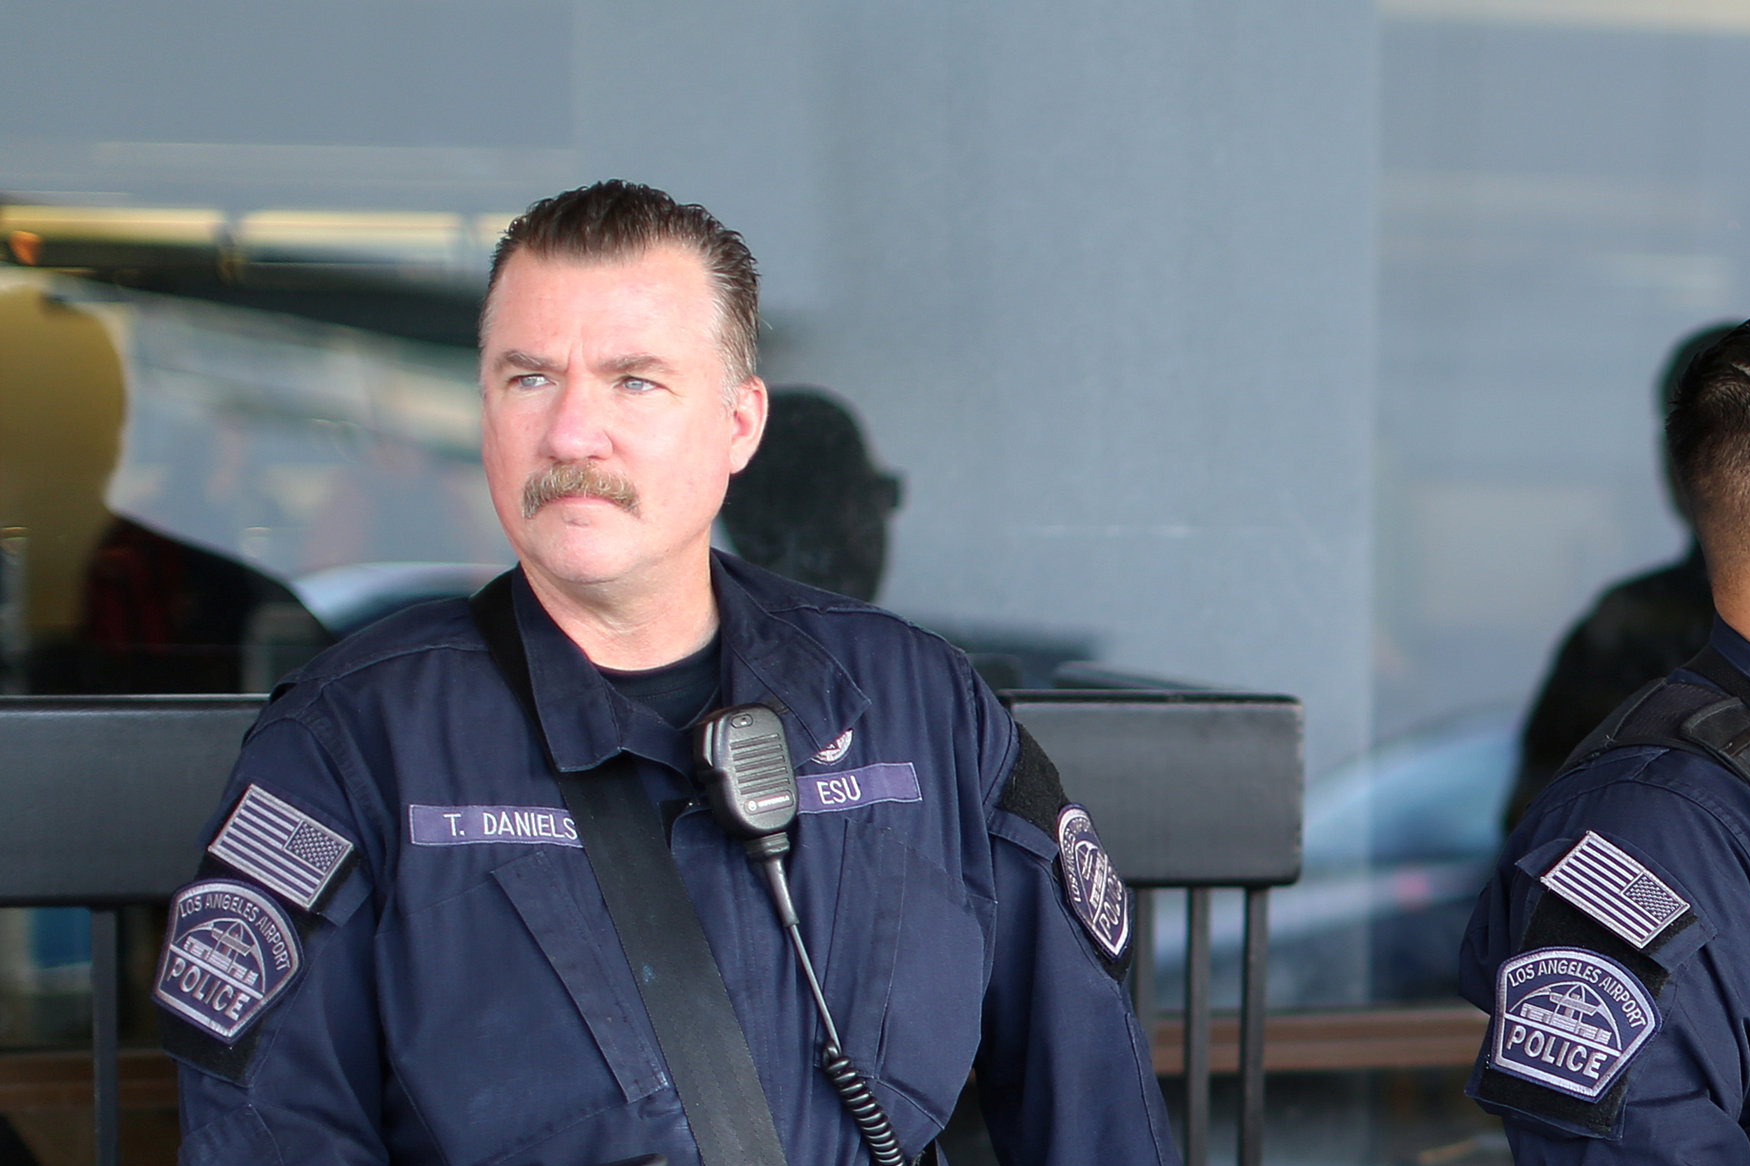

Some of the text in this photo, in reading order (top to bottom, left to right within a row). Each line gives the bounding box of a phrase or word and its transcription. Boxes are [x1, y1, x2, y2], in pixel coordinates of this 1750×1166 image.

[816, 775, 861, 804] ESU
[443, 811, 578, 840] T. DANIELS
[179, 893, 291, 970] LOS ANGELES AIRPORT
[167, 957, 250, 1021] POLICE
[1508, 959, 1646, 1028] LOS ANGELES AIRPORT
[1506, 1024, 1608, 1080] POLICE
